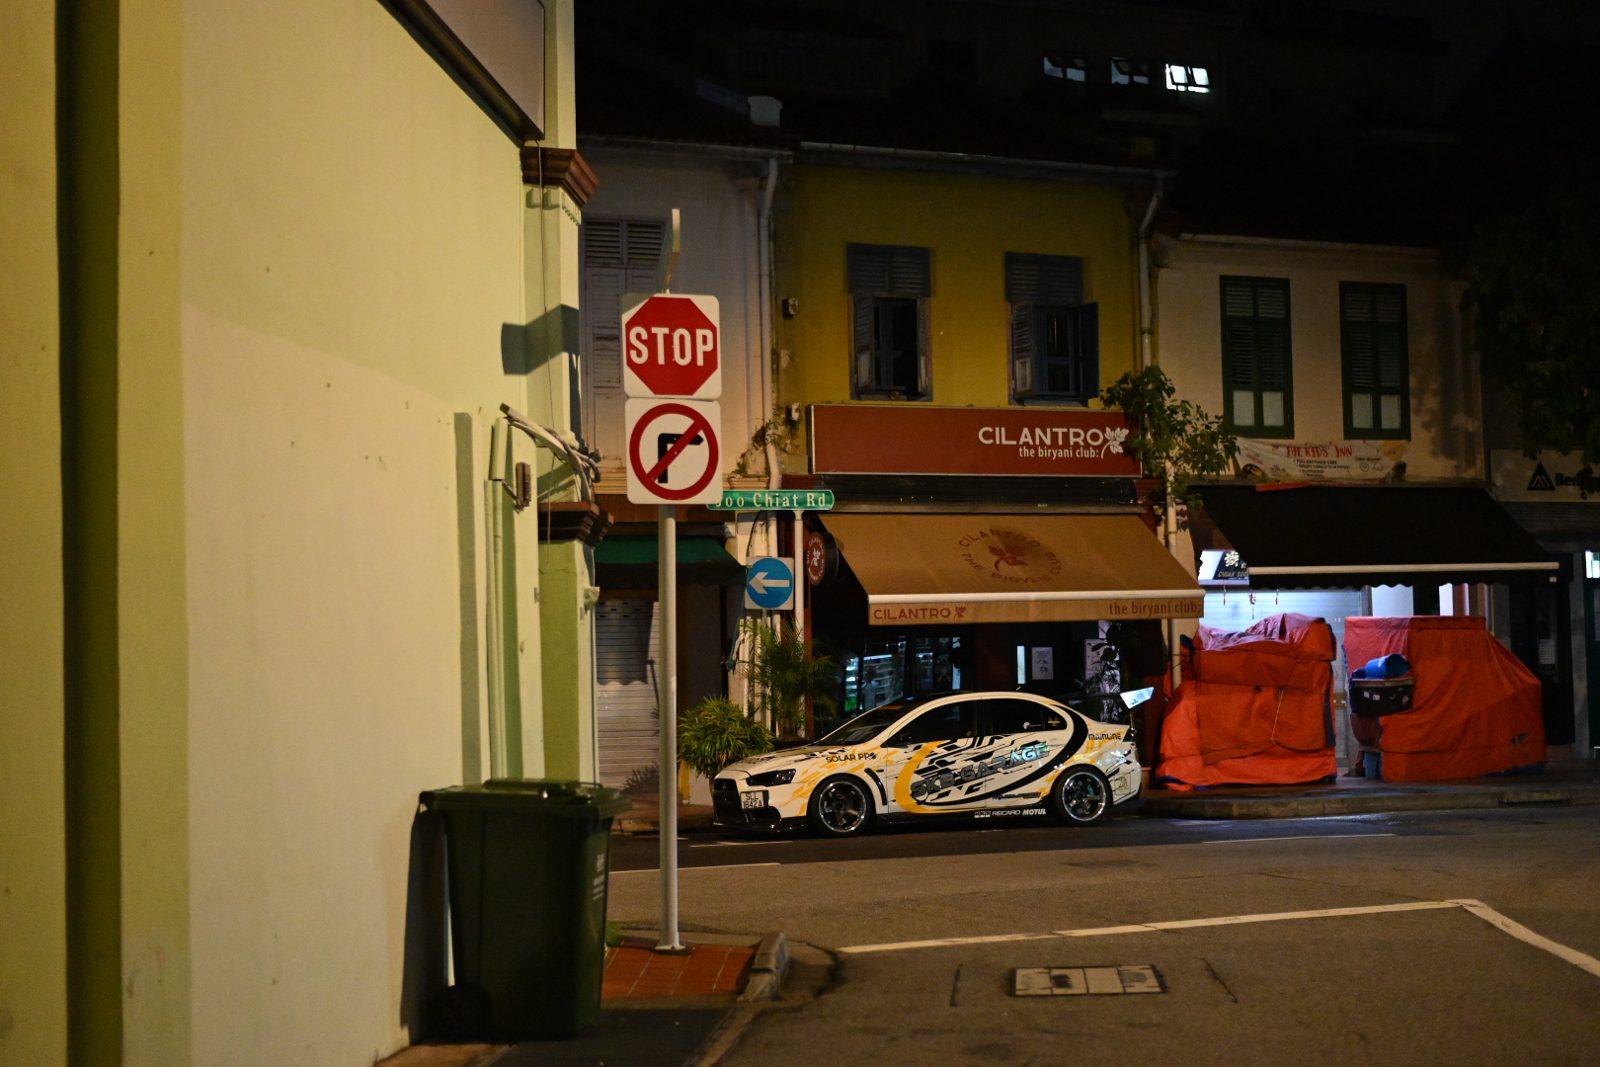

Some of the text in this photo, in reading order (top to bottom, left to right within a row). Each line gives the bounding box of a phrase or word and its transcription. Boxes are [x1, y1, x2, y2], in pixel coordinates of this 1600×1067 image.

[629, 326, 714, 367] STOP
[978, 426, 1104, 446] CILANTRO
[1019, 447, 1035, 458] the
[1038, 447, 1073, 460] biryani
[1335, 445, 1353, 458] INN
[753, 492, 799, 508] Chiat
[806, 493, 826, 507] Rd
[873, 607, 951, 620] CILANTRO
[1109, 602, 1129, 616] the
[1131, 601, 1172, 618] biryani
[825, 753, 856, 763] SOLAR
[1022, 808, 1047, 816] MOTUL
